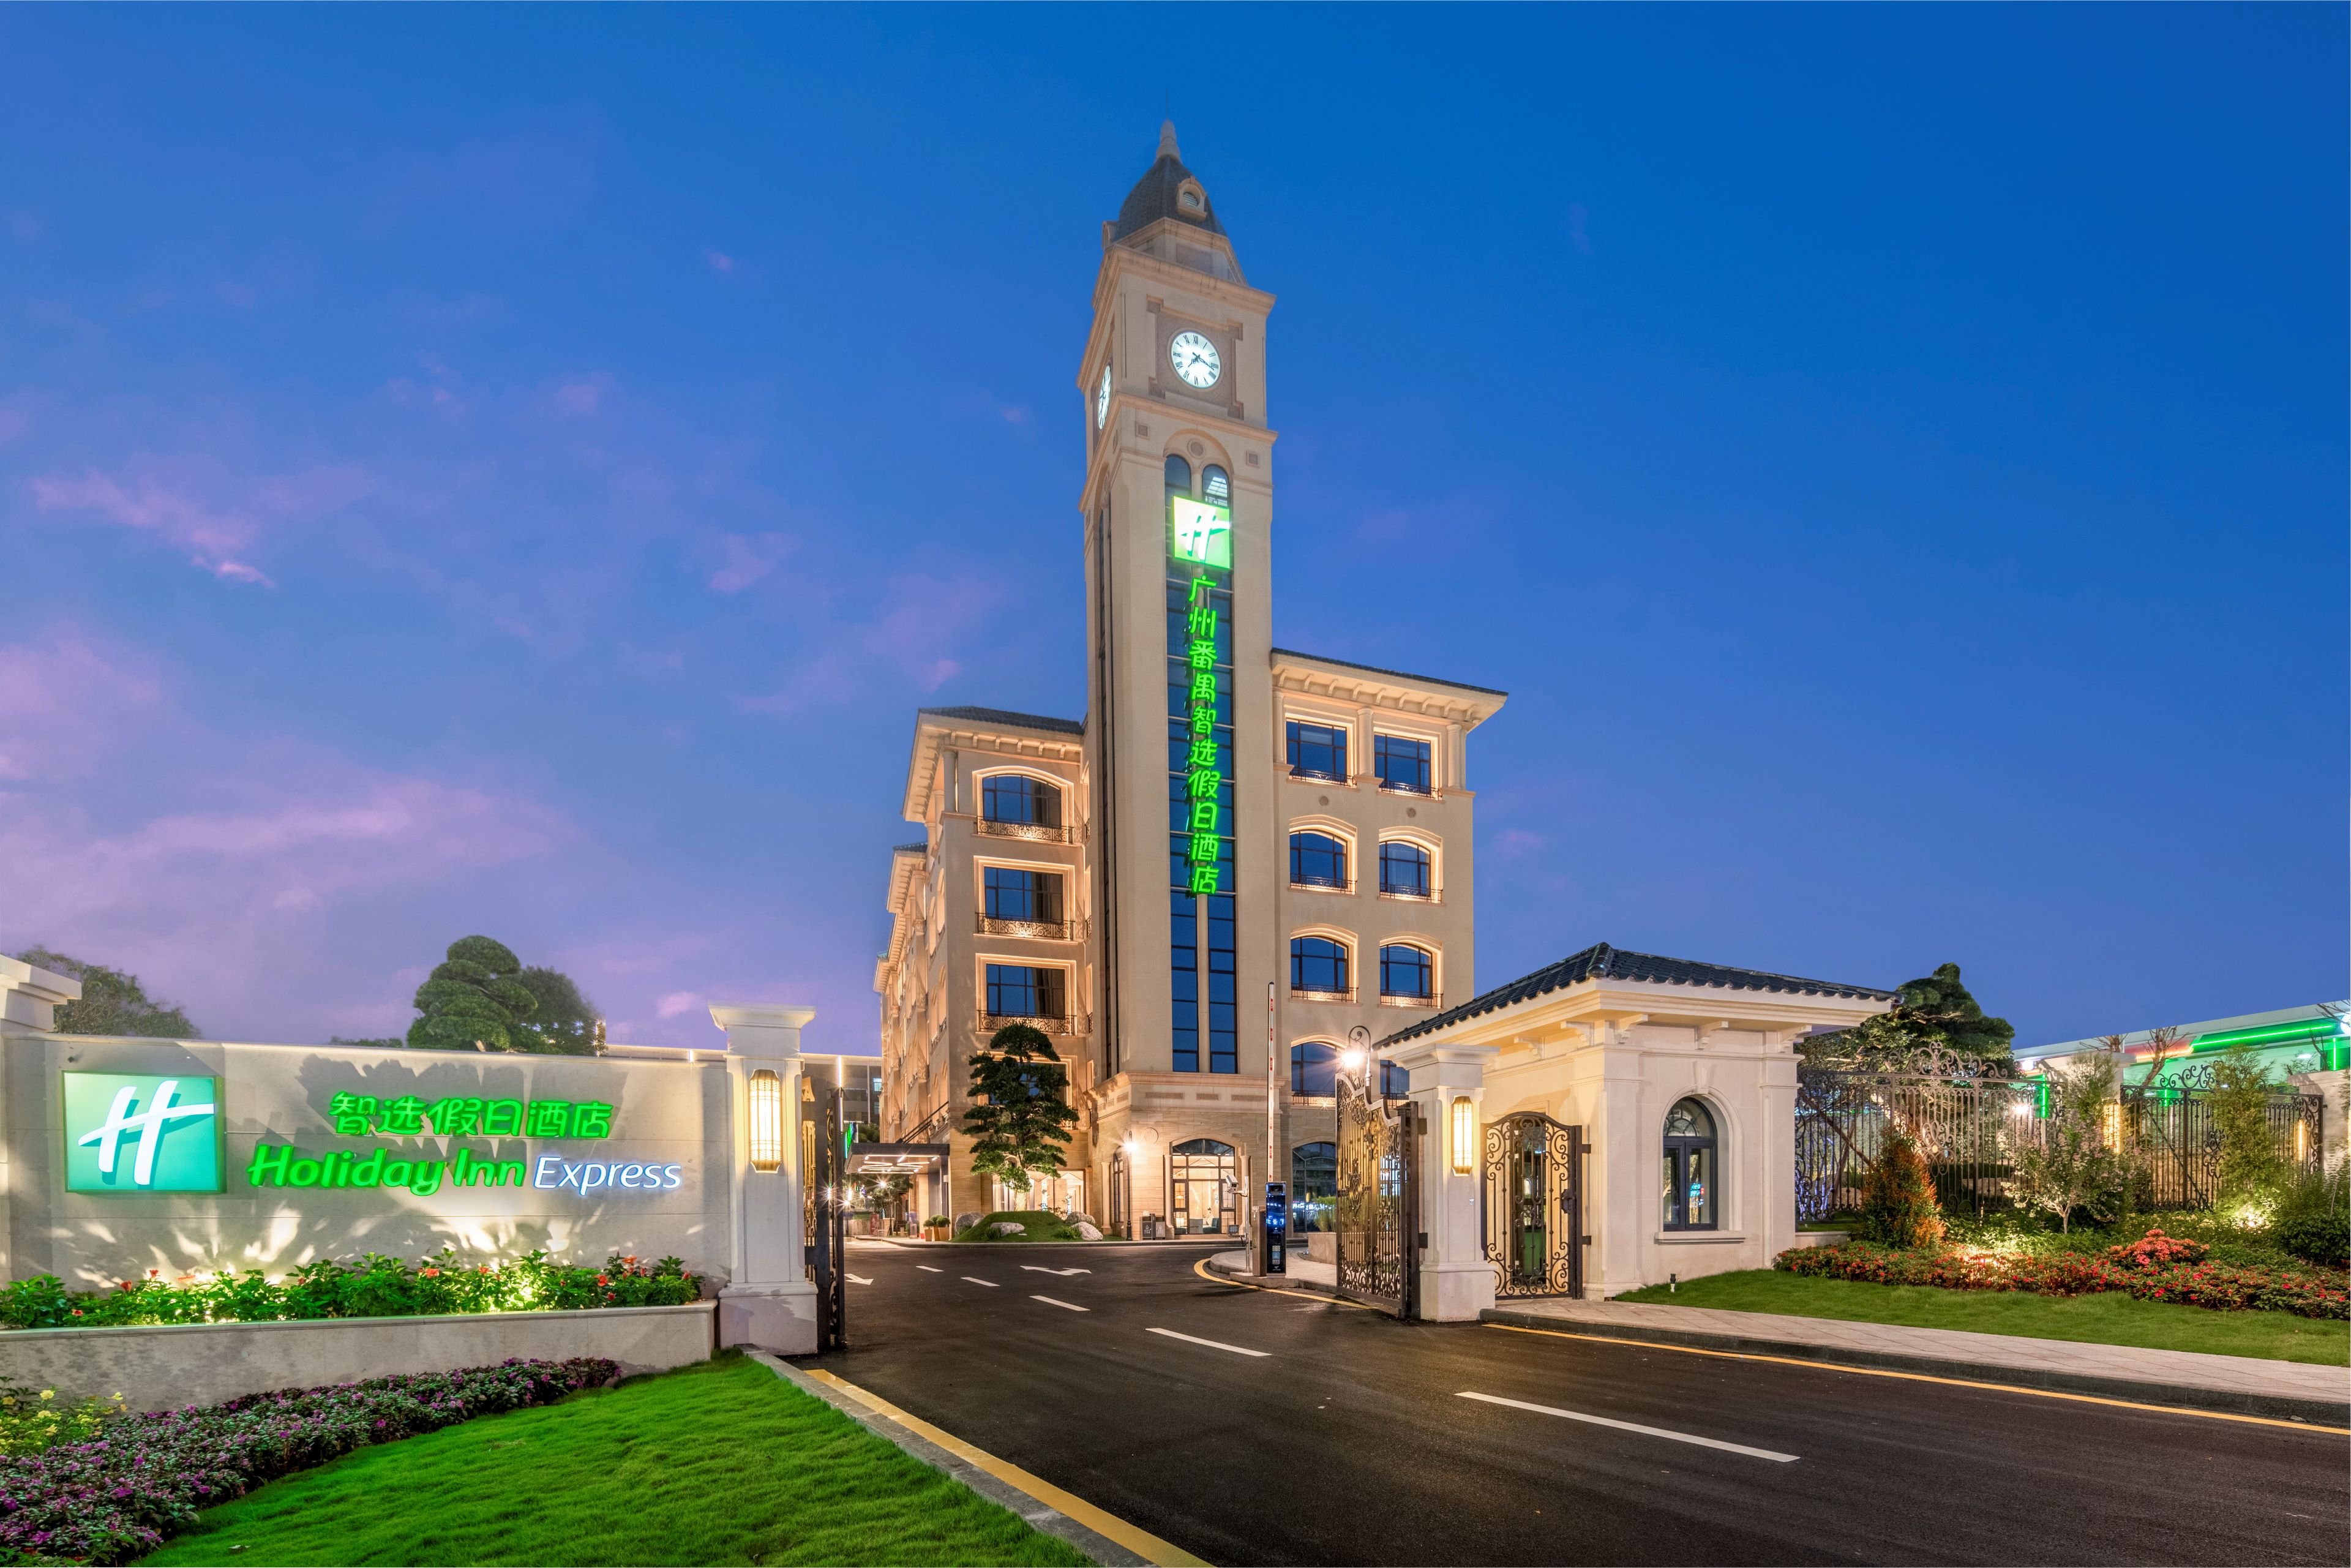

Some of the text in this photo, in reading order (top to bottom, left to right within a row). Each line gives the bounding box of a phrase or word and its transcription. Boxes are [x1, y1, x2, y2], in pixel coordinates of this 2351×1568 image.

[1188, 574, 1222, 896] 广州番禺智选假日酒店
[328, 1090, 613, 1139] 智选假日酒店
[246, 1144, 683, 1196] Holiday Inn Express
